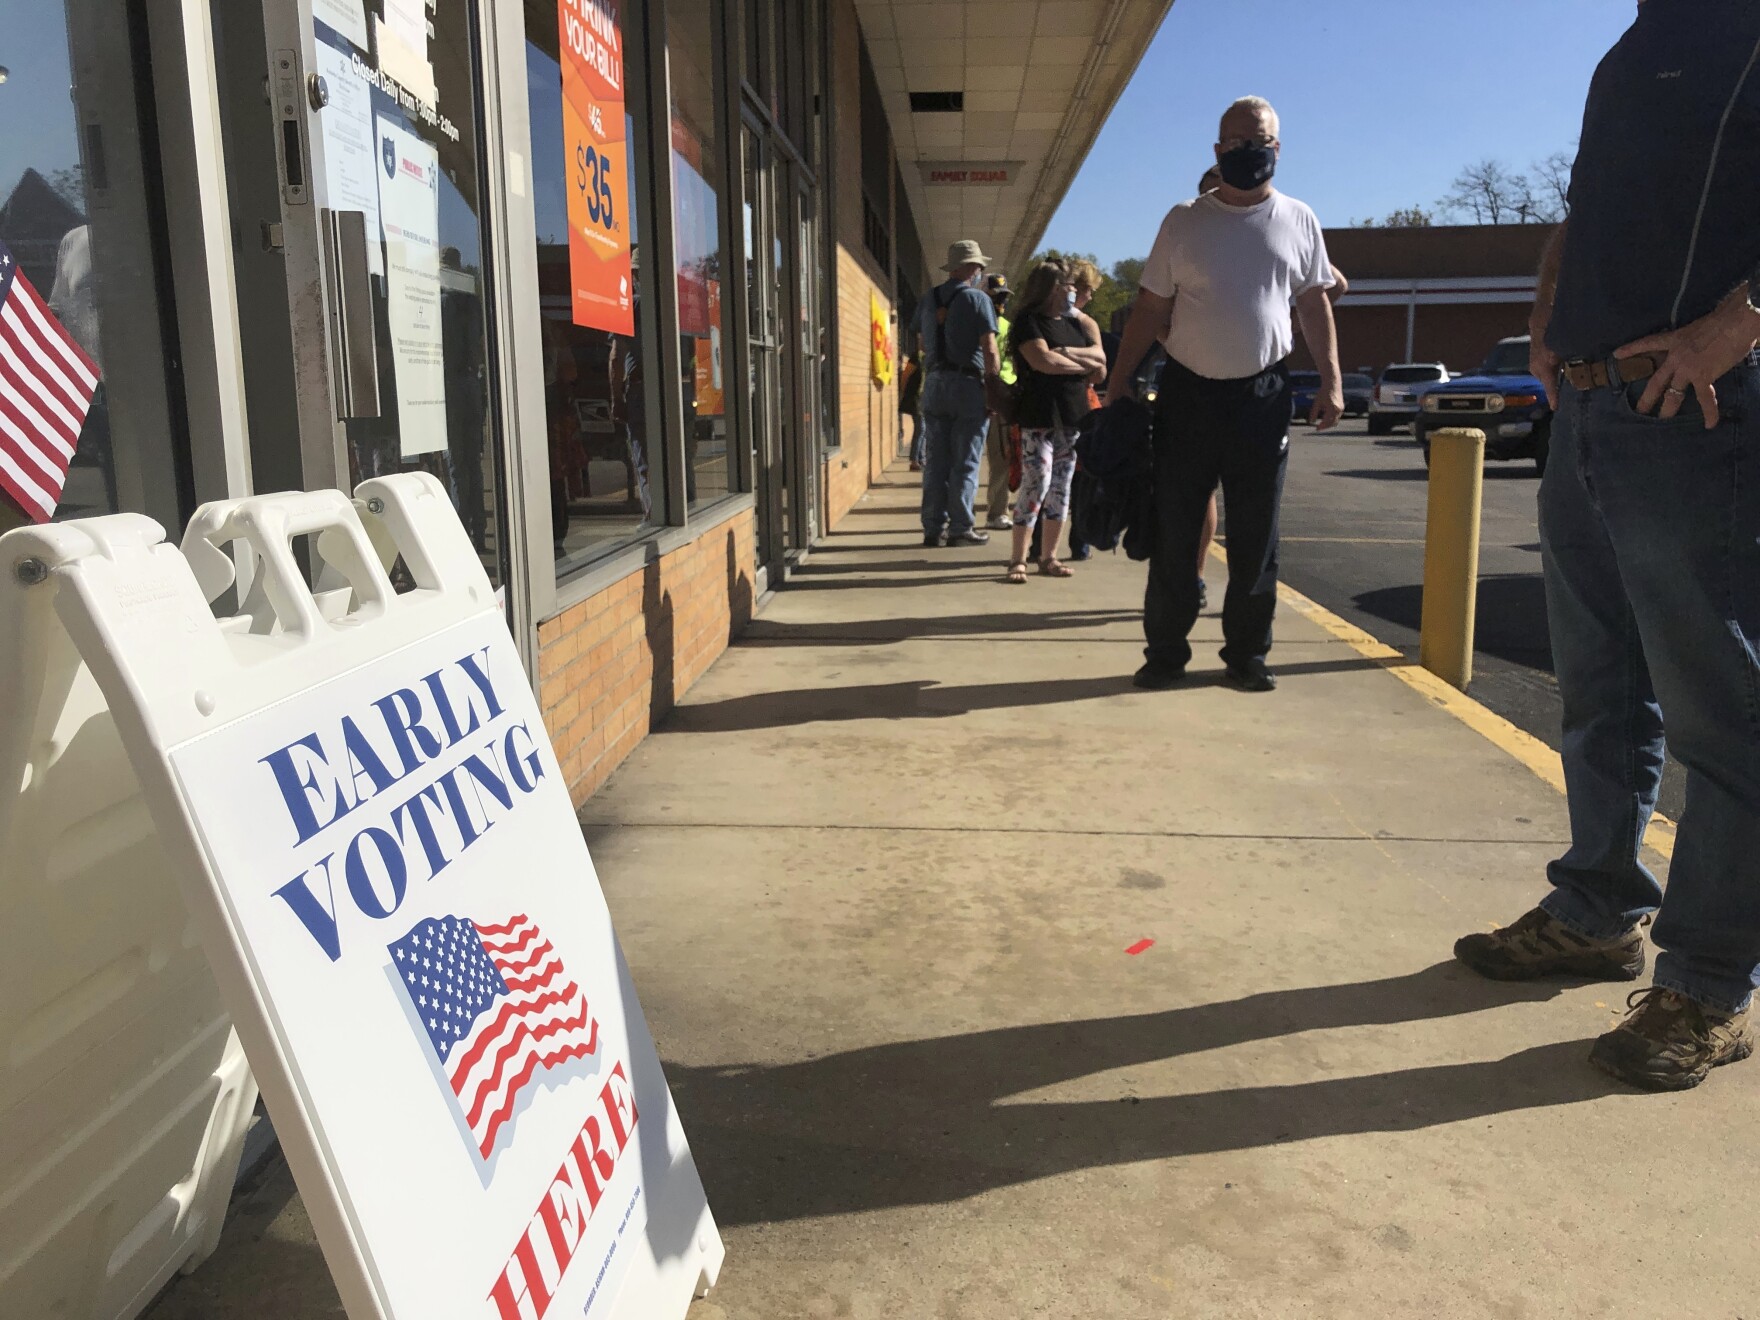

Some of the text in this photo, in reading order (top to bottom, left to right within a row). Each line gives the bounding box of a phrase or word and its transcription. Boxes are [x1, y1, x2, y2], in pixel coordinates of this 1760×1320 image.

[564, 9, 620, 91] YOUR BILL!
[566, 0, 618, 52] RINK
[351, 52, 380, 88] Closed
[380, 72, 399, 105] Daily
[399, 85, 415, 111] from
[577, 139, 613, 230] $35
[257, 646, 506, 848] EARLY
[270, 718, 546, 963] VOTING
[486, 1059, 640, 1320] HERE
